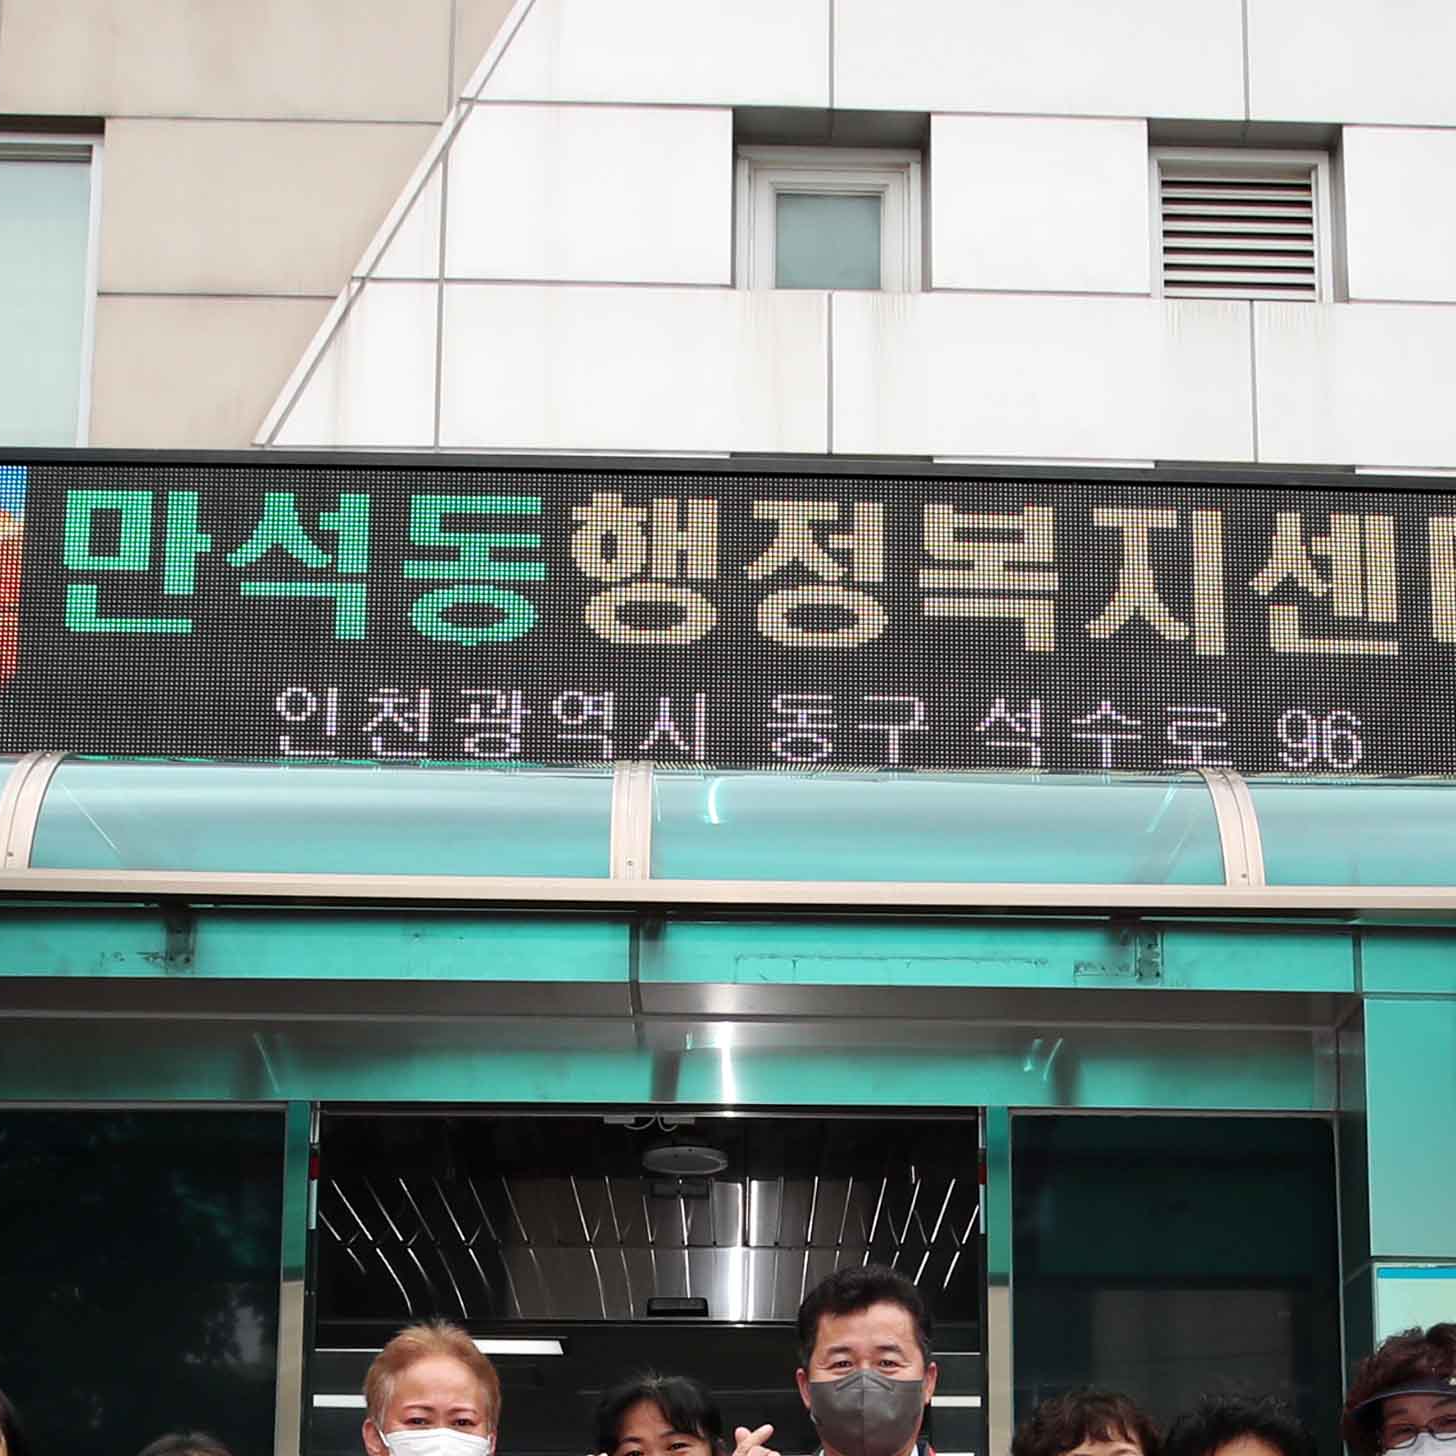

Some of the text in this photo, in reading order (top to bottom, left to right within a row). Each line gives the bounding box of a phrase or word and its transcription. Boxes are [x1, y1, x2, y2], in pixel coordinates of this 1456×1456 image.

[276, 686, 1363, 768] 인천광역시 동구 석수로 96
